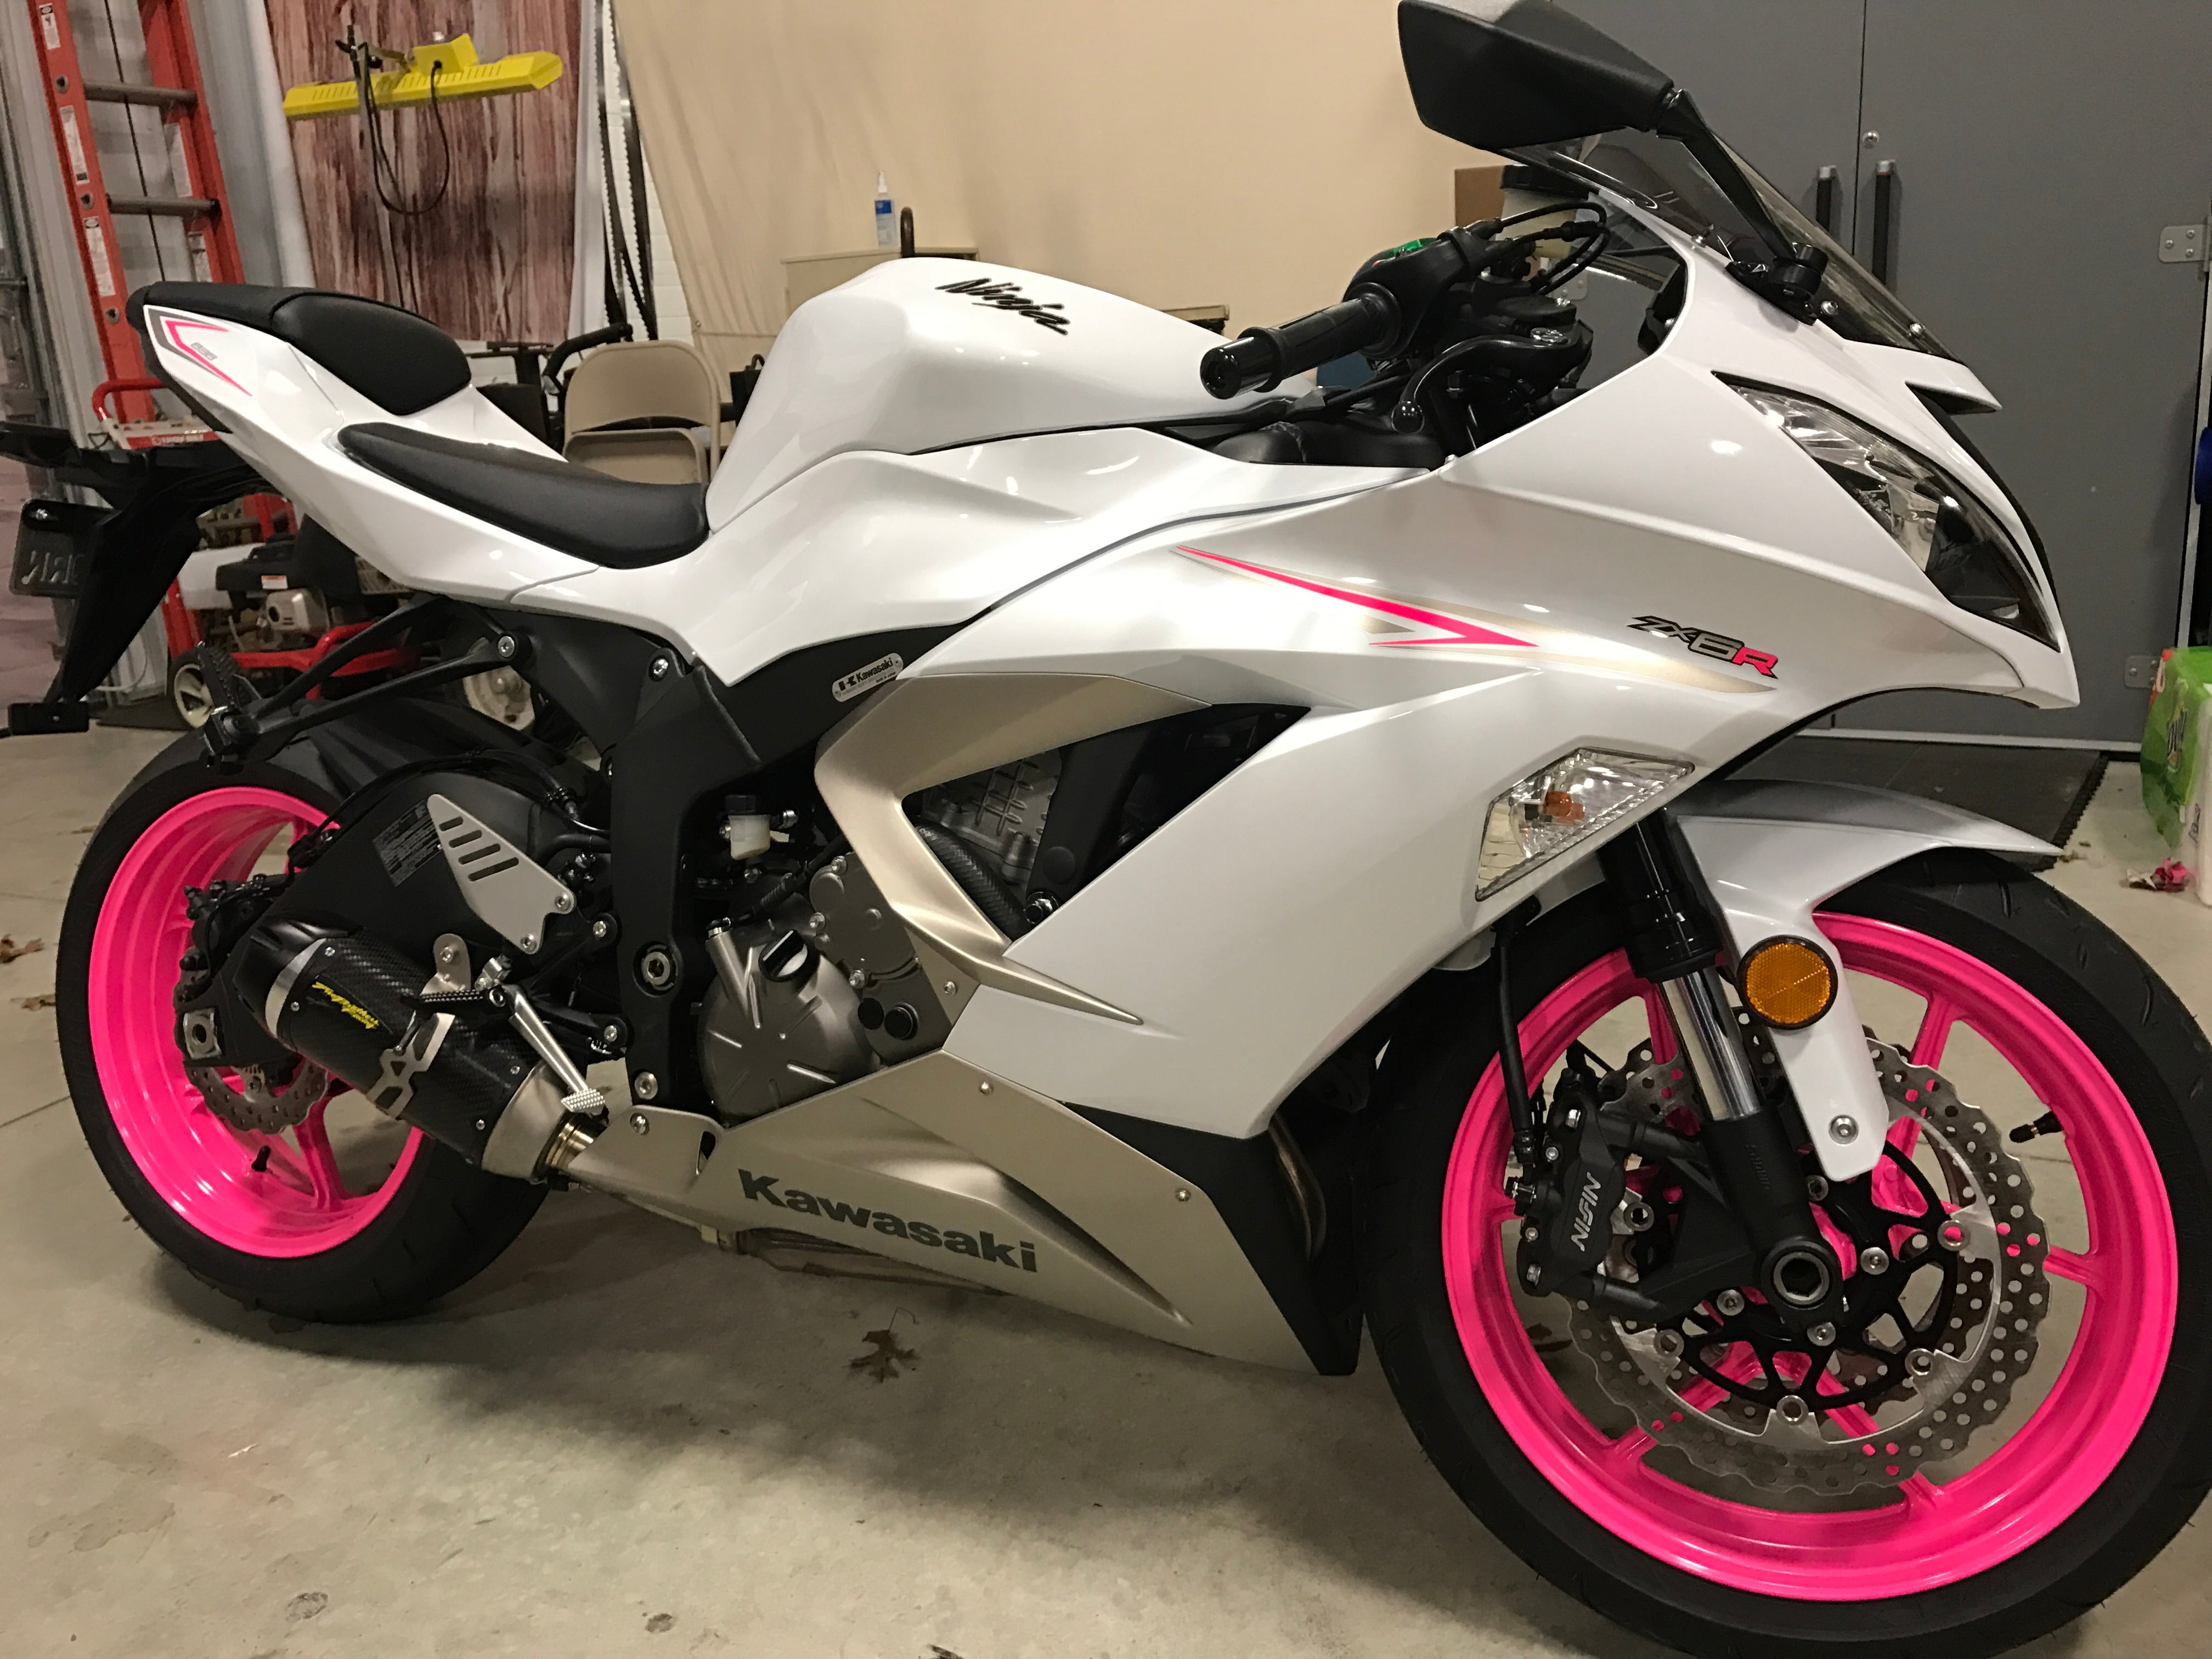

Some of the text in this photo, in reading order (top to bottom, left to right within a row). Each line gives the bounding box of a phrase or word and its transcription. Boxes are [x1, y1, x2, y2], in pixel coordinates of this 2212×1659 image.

[935, 278, 1070, 335] Ninja
[856, 657, 893, 682] Kawasaki
[738, 1168, 1037, 1272] Kawasaki
[1571, 1171, 1601, 1252] NISSIN
